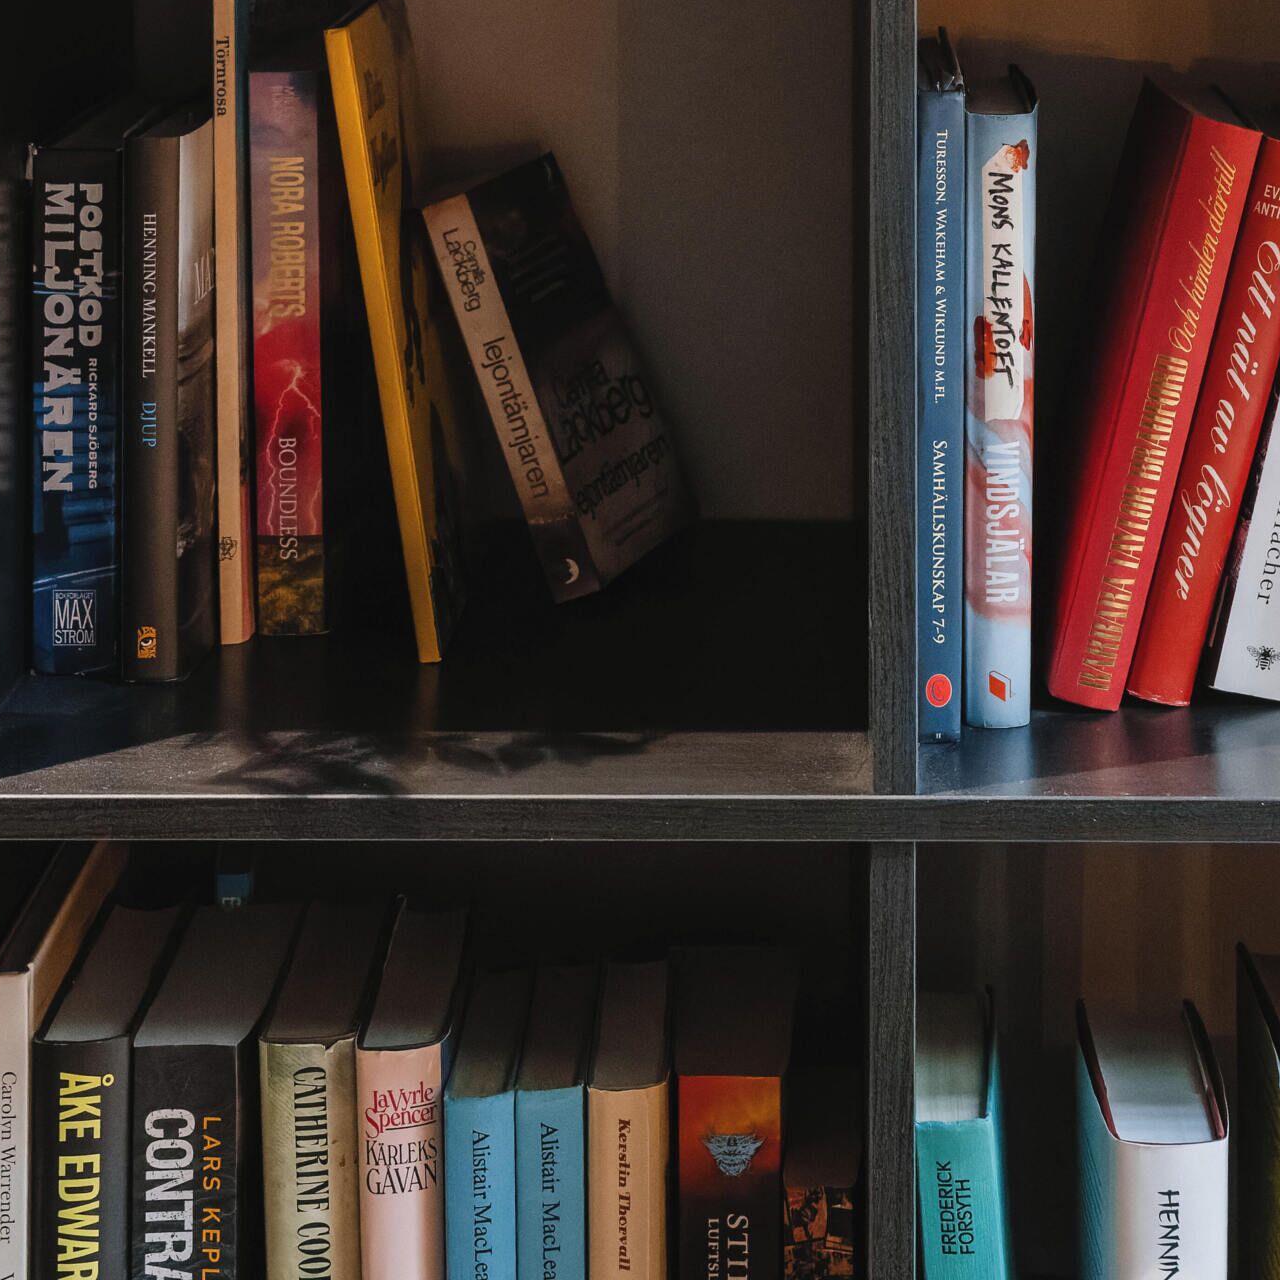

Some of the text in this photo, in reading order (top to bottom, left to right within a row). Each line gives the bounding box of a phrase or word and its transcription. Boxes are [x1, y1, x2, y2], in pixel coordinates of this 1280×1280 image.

[215, 36, 231, 117] Törnrosa
[141, 212, 158, 448] HENNING MANKELL DJUP
[1222, 313, 1259, 396] nät
[88, 358, 101, 490] RICKARD SJÖBERG
[483, 336, 549, 498] lejontämjaren
[985, 173, 1023, 604] MONS KALLENTOFT VINDSJÄLAR
[1208, 398, 1236, 456] av
[276, 436, 299, 560] BOUNDLESS
[1172, 464, 1232, 604] lögner
[59, 1072, 114, 1143] ÅKE
[365, 1136, 438, 1166] KÄRLEKS
[0, 1145, 16, 1244] Warrender
[617, 1118, 631, 1272] Kerstin Thorvall
[935, 1160, 955, 1255] FREDERICK
[957, 1179, 974, 1255] FORSYTH
